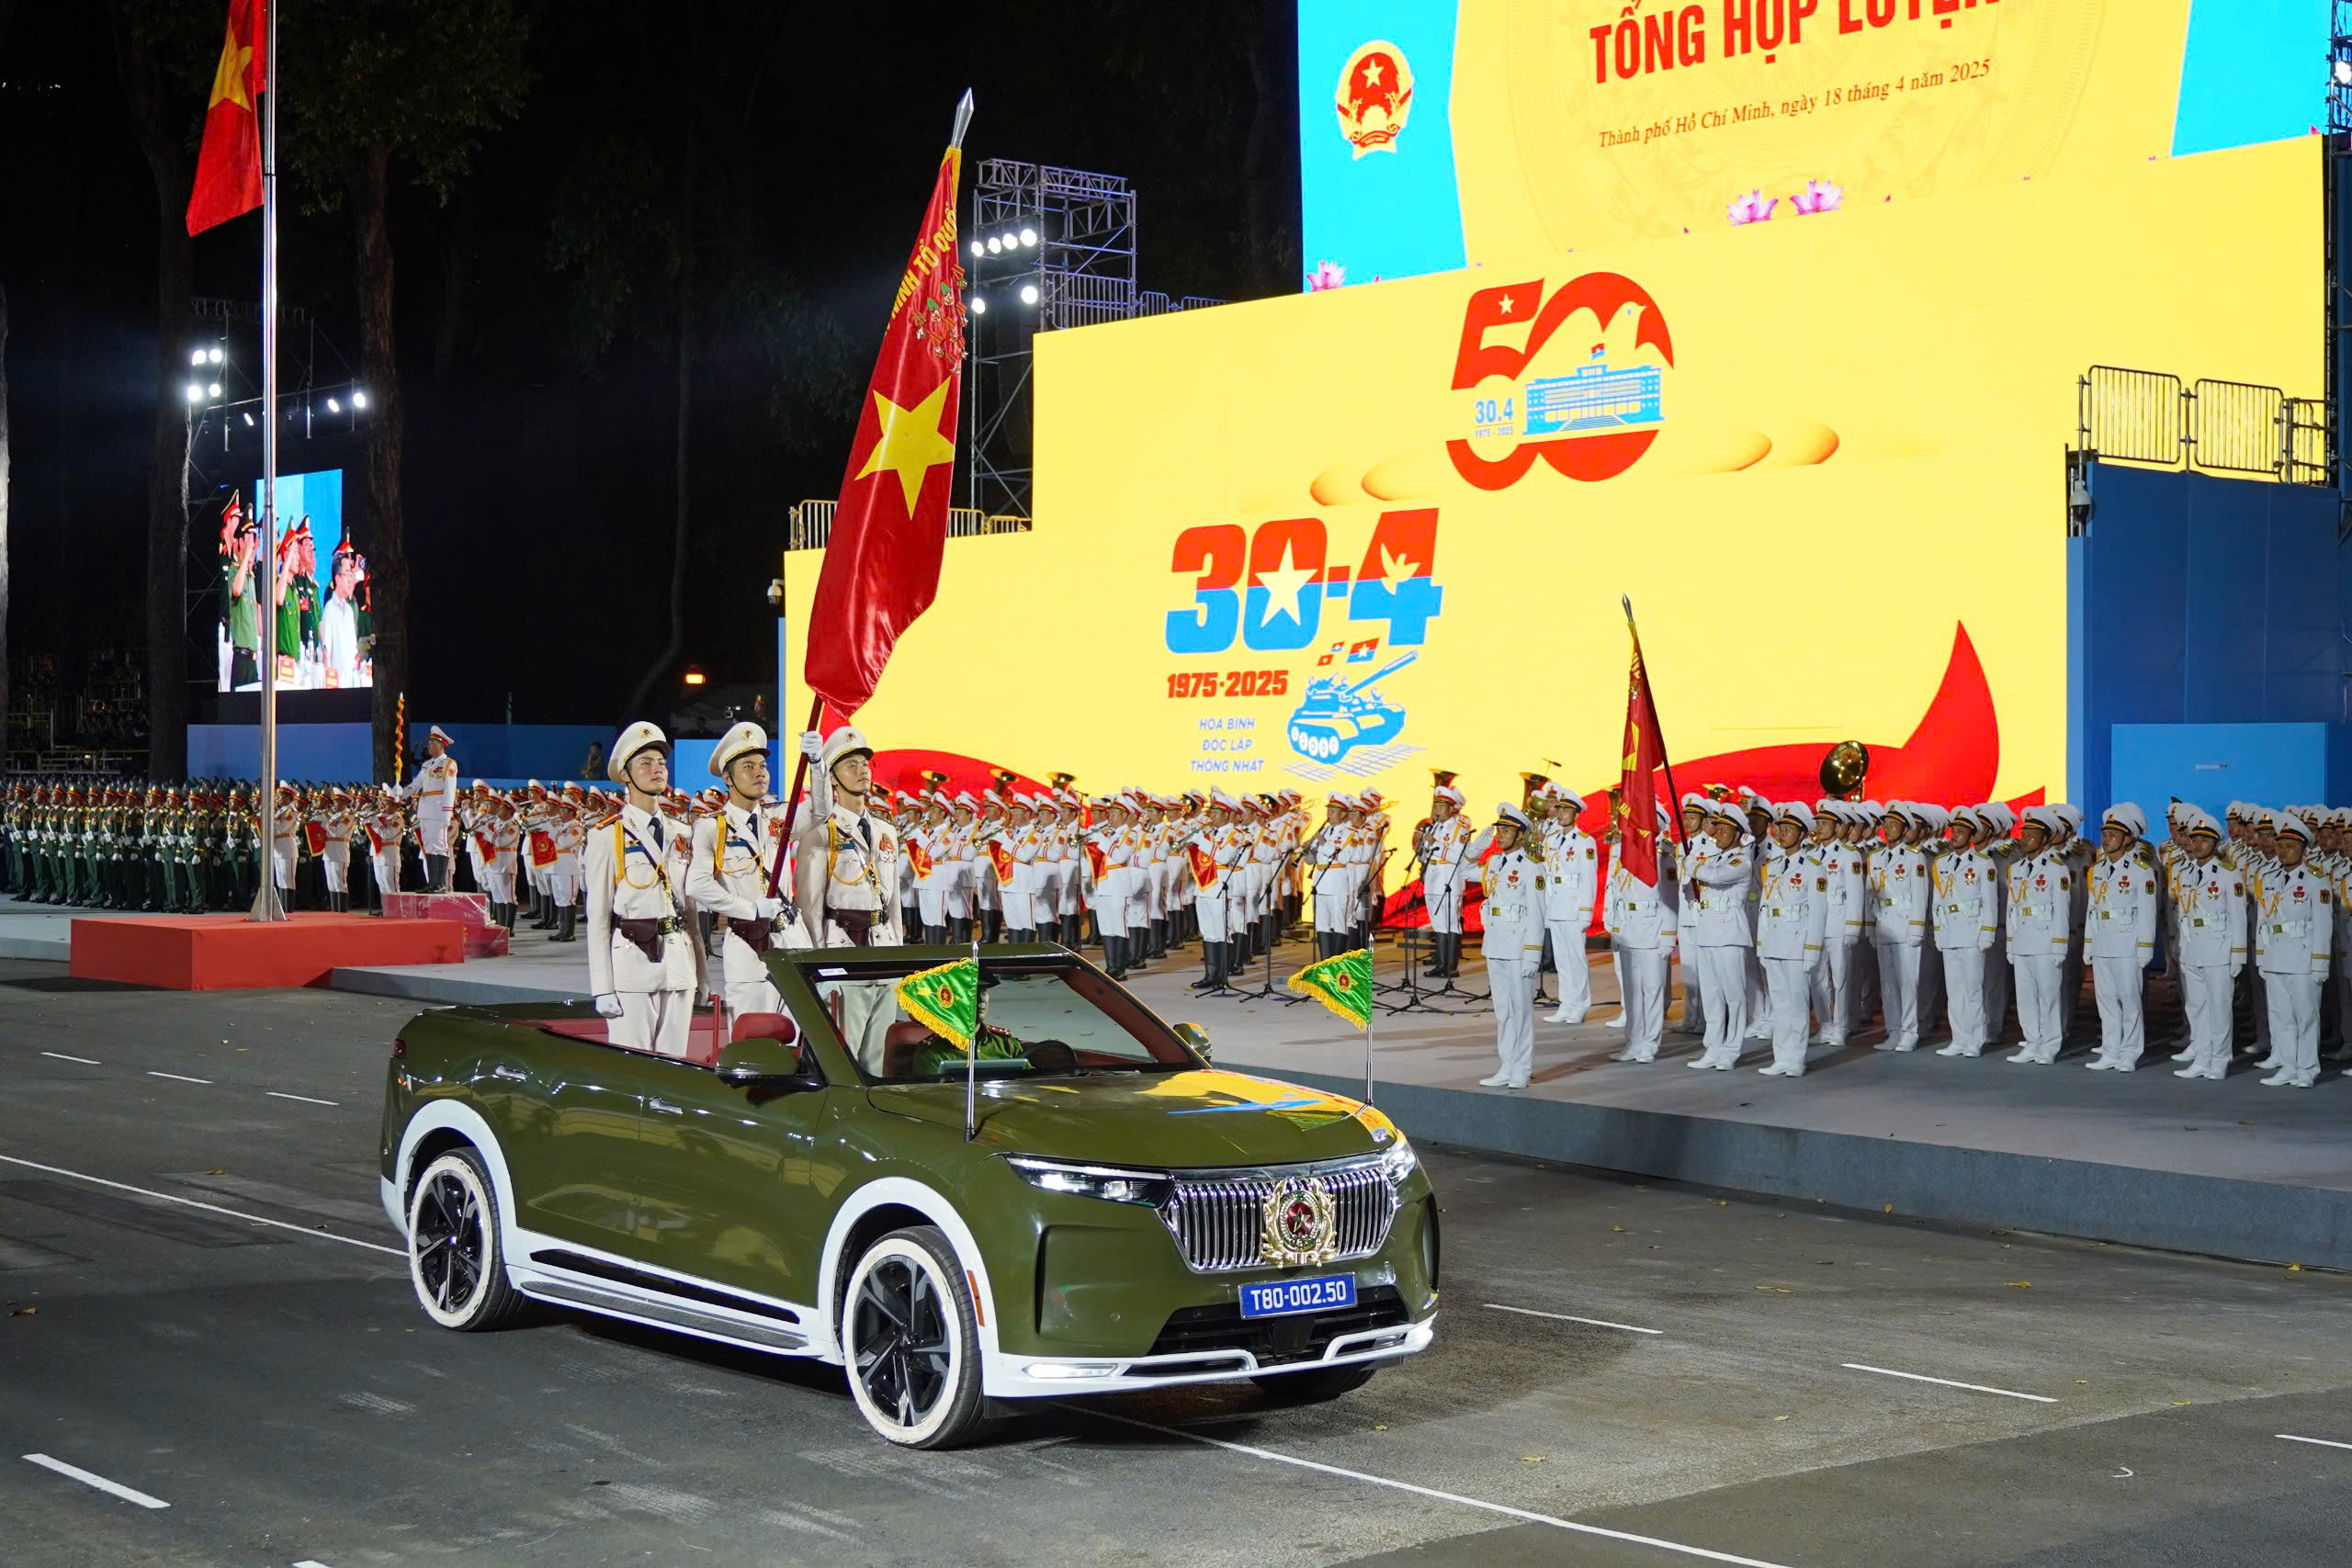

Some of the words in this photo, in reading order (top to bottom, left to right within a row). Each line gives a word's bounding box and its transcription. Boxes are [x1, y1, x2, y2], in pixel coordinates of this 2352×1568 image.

[1589, 0, 1705, 84] TỔNG
[1599, 126, 1640, 147] Thành
[1644, 117, 1673, 145] phố
[1675, 112, 1696, 134] Hồ
[1701, 108, 1728, 129] Chí
[1732, 101, 1774, 124] Minh,
[1781, 94, 1817, 117] ngày
[1825, 87, 1842, 107] 18
[1847, 82, 1890, 101] tháng
[1894, 75, 1905, 92] 4
[1910, 72, 1943, 90] năm
[1950, 58, 1991, 84] 2025
[933, 200, 957, 253] QUỐ
[1475, 398, 1514, 423] 30.4
[1250, 1280, 1347, 1311] T80-002.50
